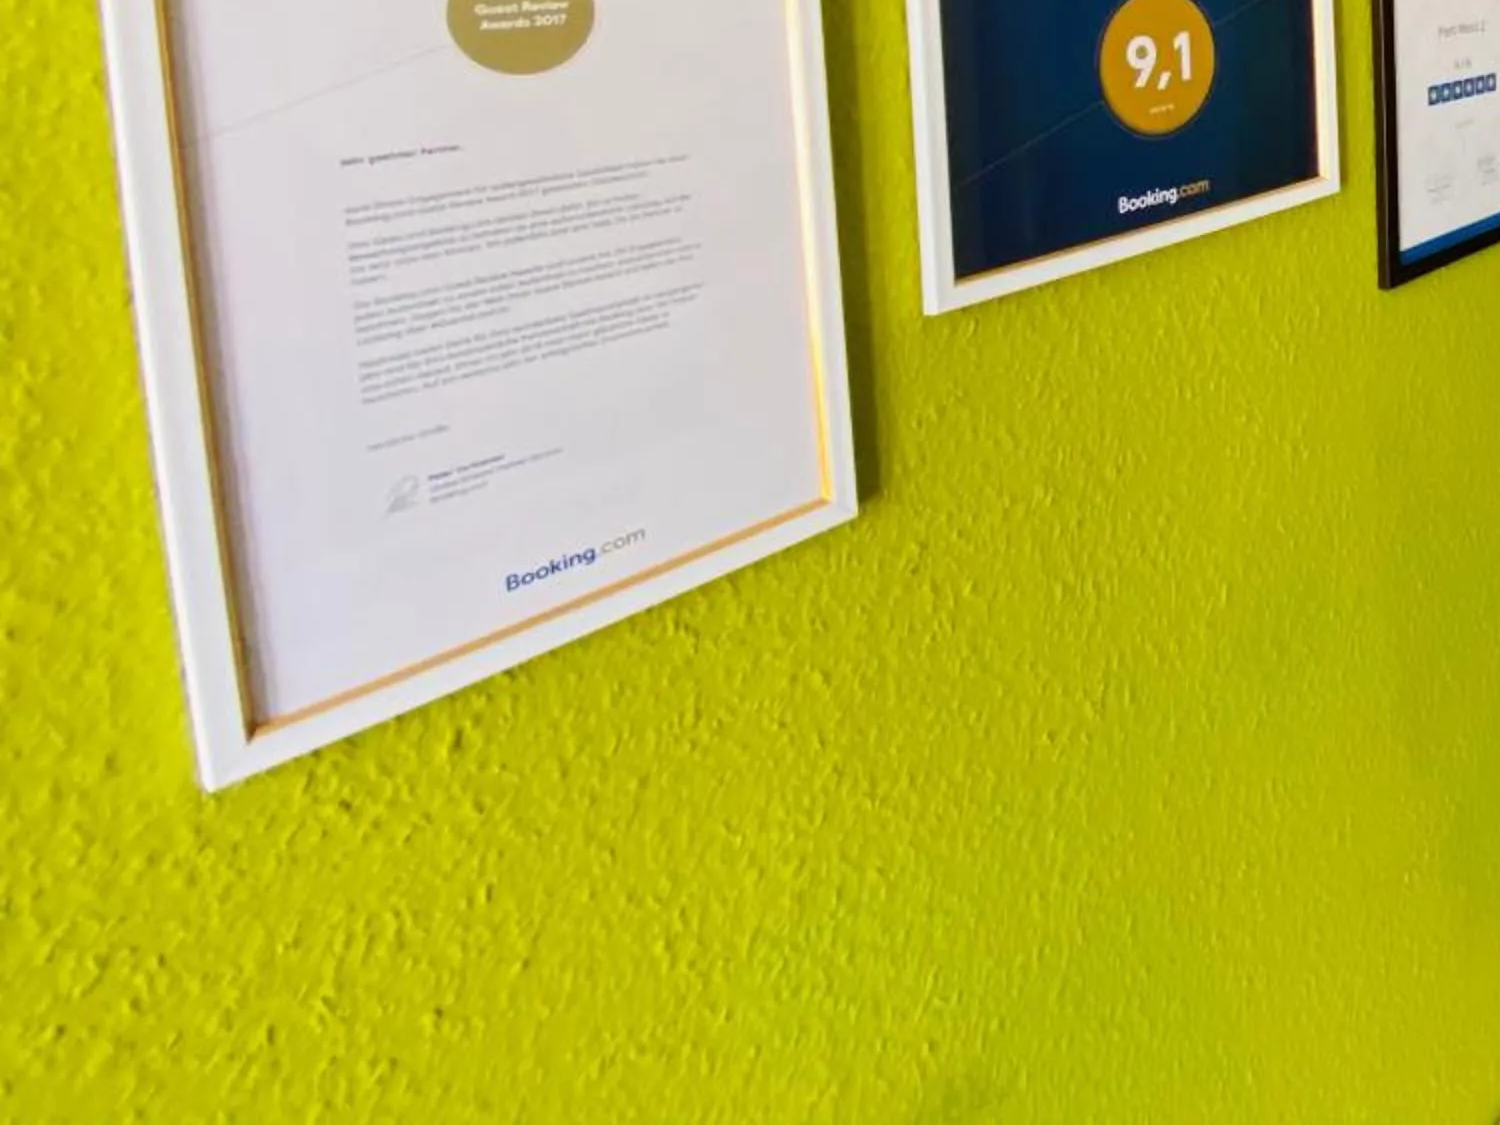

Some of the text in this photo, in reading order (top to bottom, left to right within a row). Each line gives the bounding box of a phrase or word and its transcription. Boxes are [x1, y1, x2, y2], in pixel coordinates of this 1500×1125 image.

[473, 0, 569, 16] Guest Review
[479, 13, 567, 31] Awards 2017
[1126, 31, 1193, 91] 9,1
[1117, 180, 1210, 214] Booking.com
[505, 527, 647, 593] Booking.com
